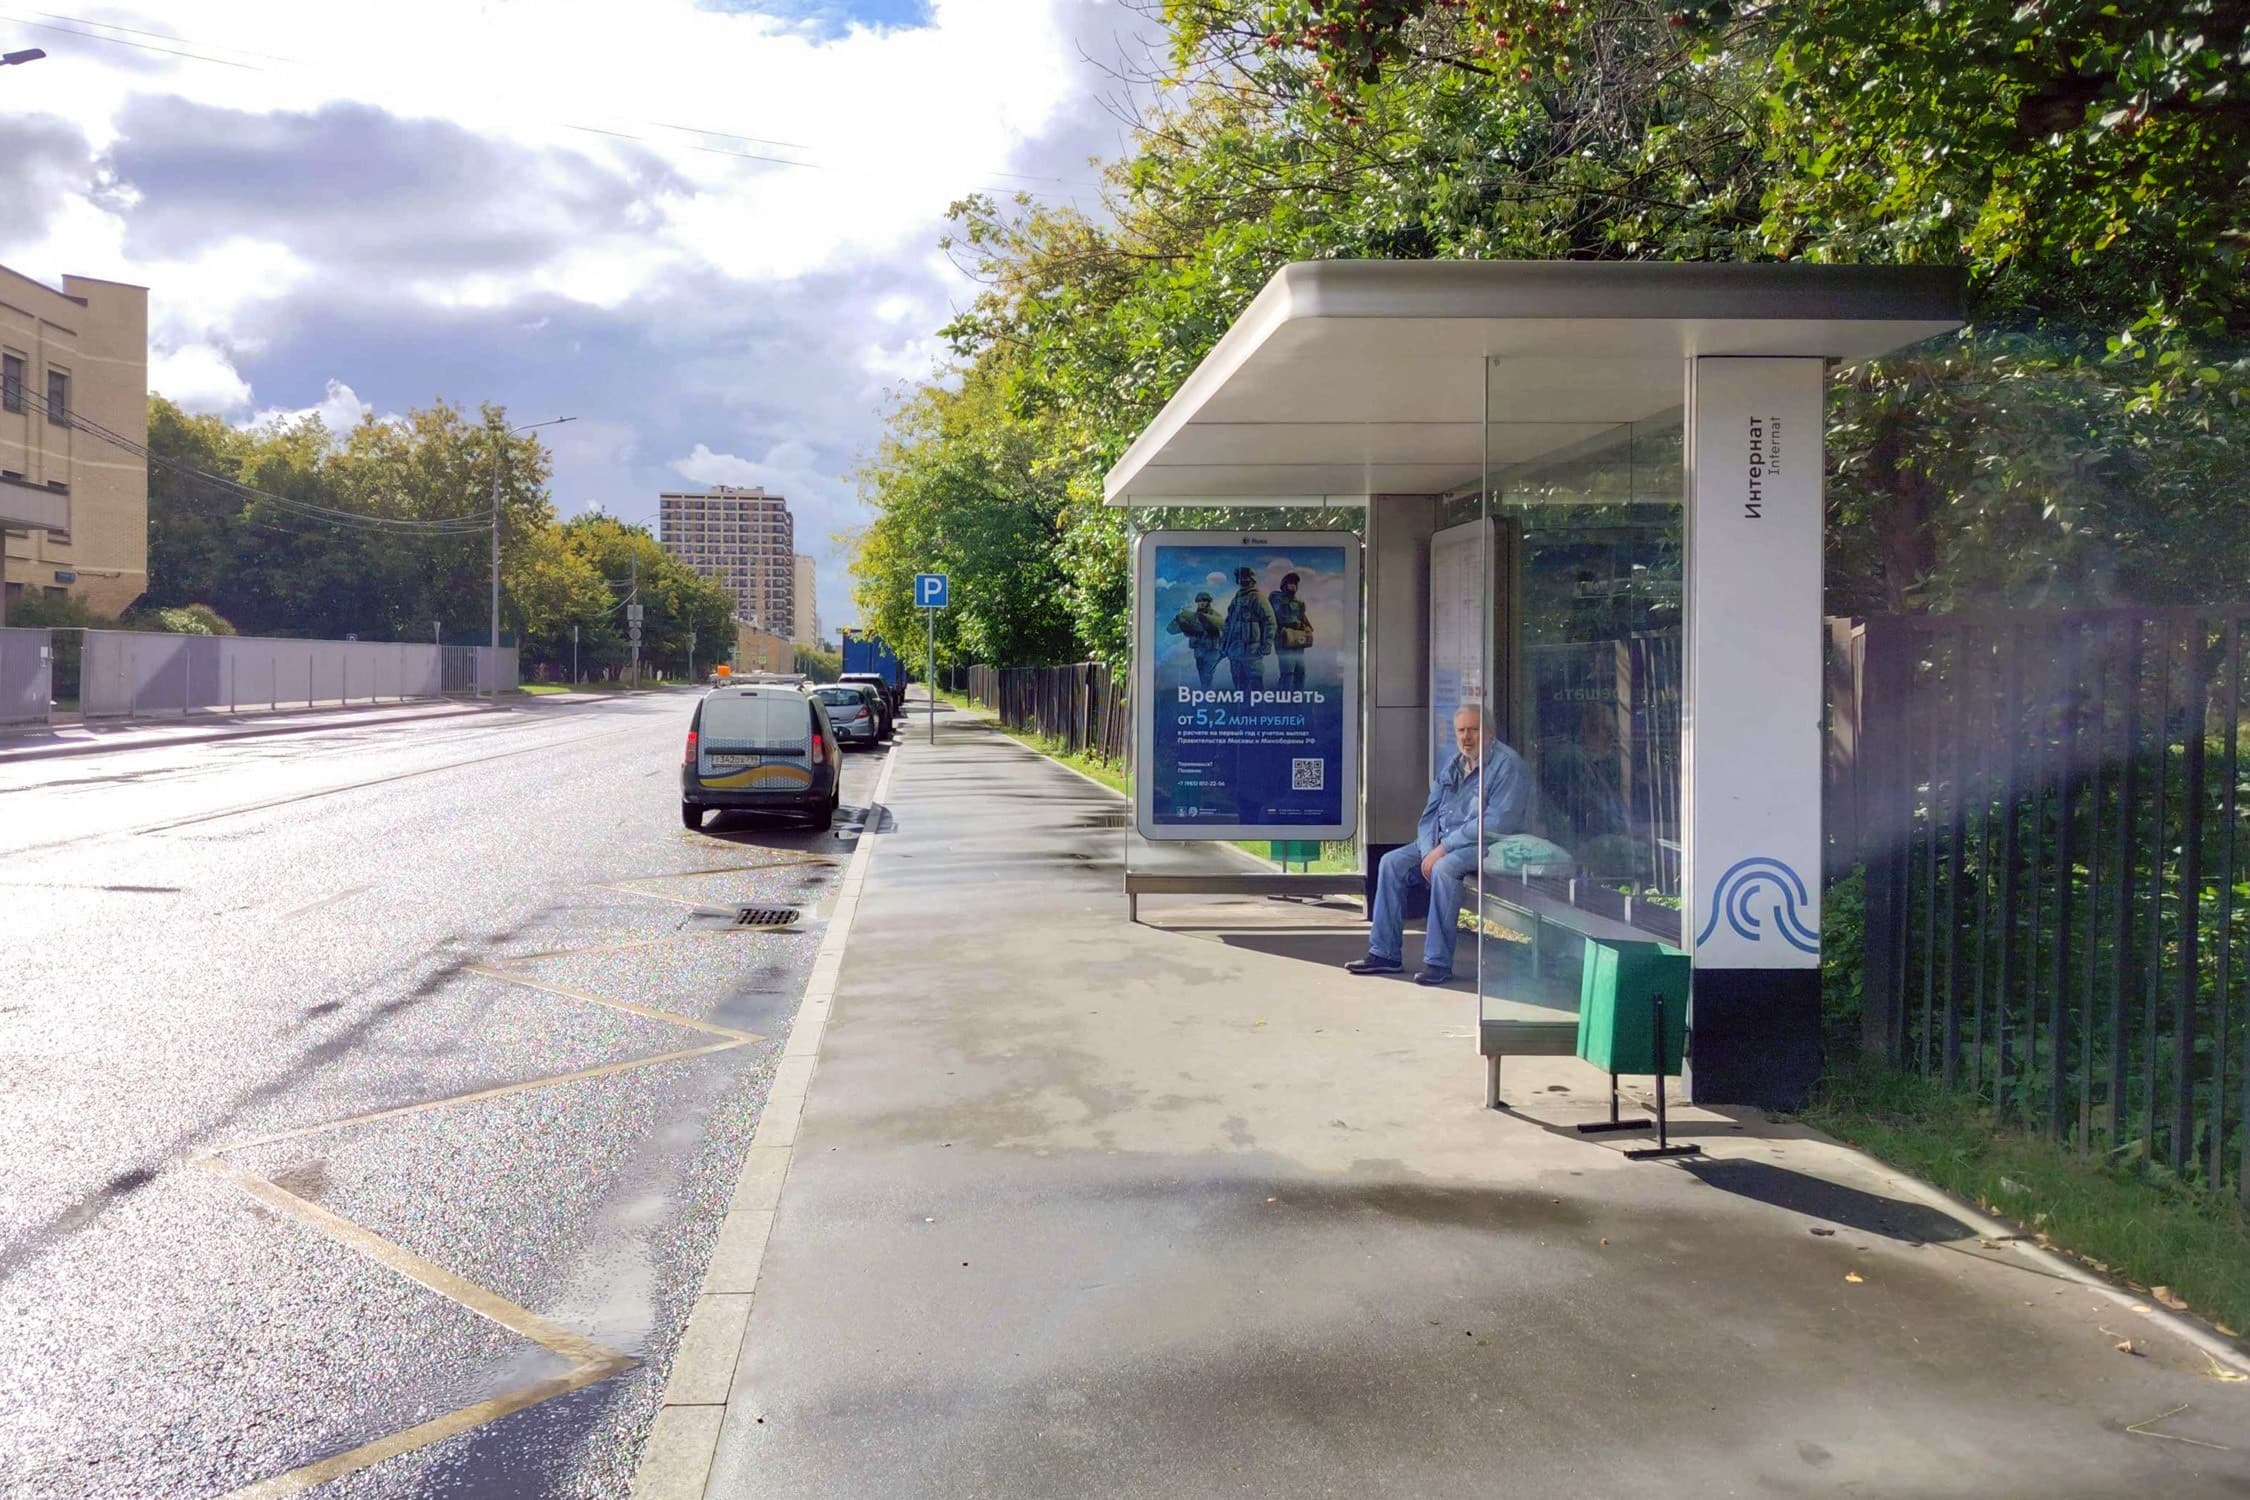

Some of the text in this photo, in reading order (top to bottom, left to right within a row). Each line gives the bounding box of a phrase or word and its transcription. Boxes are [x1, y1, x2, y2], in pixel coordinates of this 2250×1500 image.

[1768, 416, 1781, 476] Internat
[1745, 416, 1765, 519] Интернат
[924, 577, 943, 604] P
[1177, 686, 1325, 706] Время решать
[1177, 708, 1305, 728] от 5,2 МЛН РУБЛЕЙ
[1177, 737, 1227, 745] Правительства
[1305, 737, 1317, 745] РФ
[1219, 729, 1244, 737] первый
